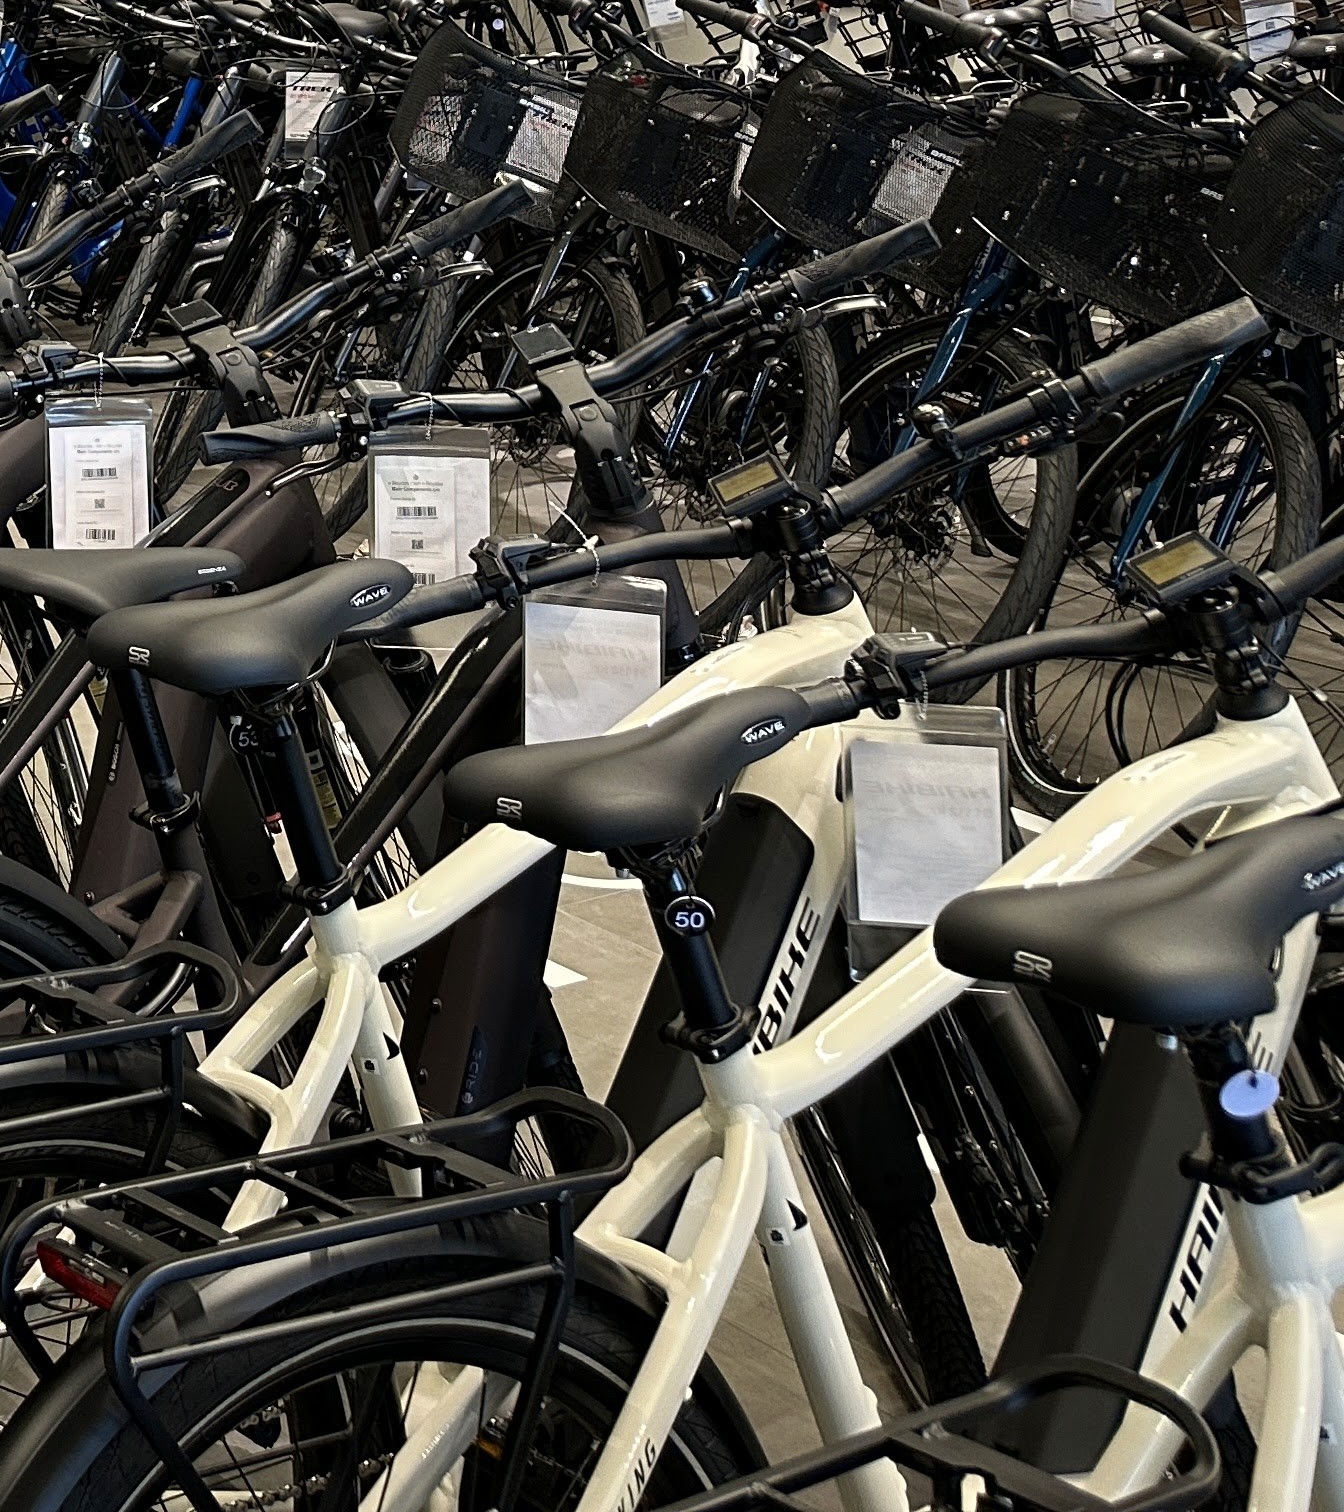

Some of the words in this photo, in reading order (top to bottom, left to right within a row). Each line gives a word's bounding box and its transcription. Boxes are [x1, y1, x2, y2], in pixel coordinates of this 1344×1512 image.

[292, 85, 332, 93] TREK
[353, 586, 389, 607] WAVE
[744, 719, 786, 744] WAVE
[675, 911, 706, 929] 50
